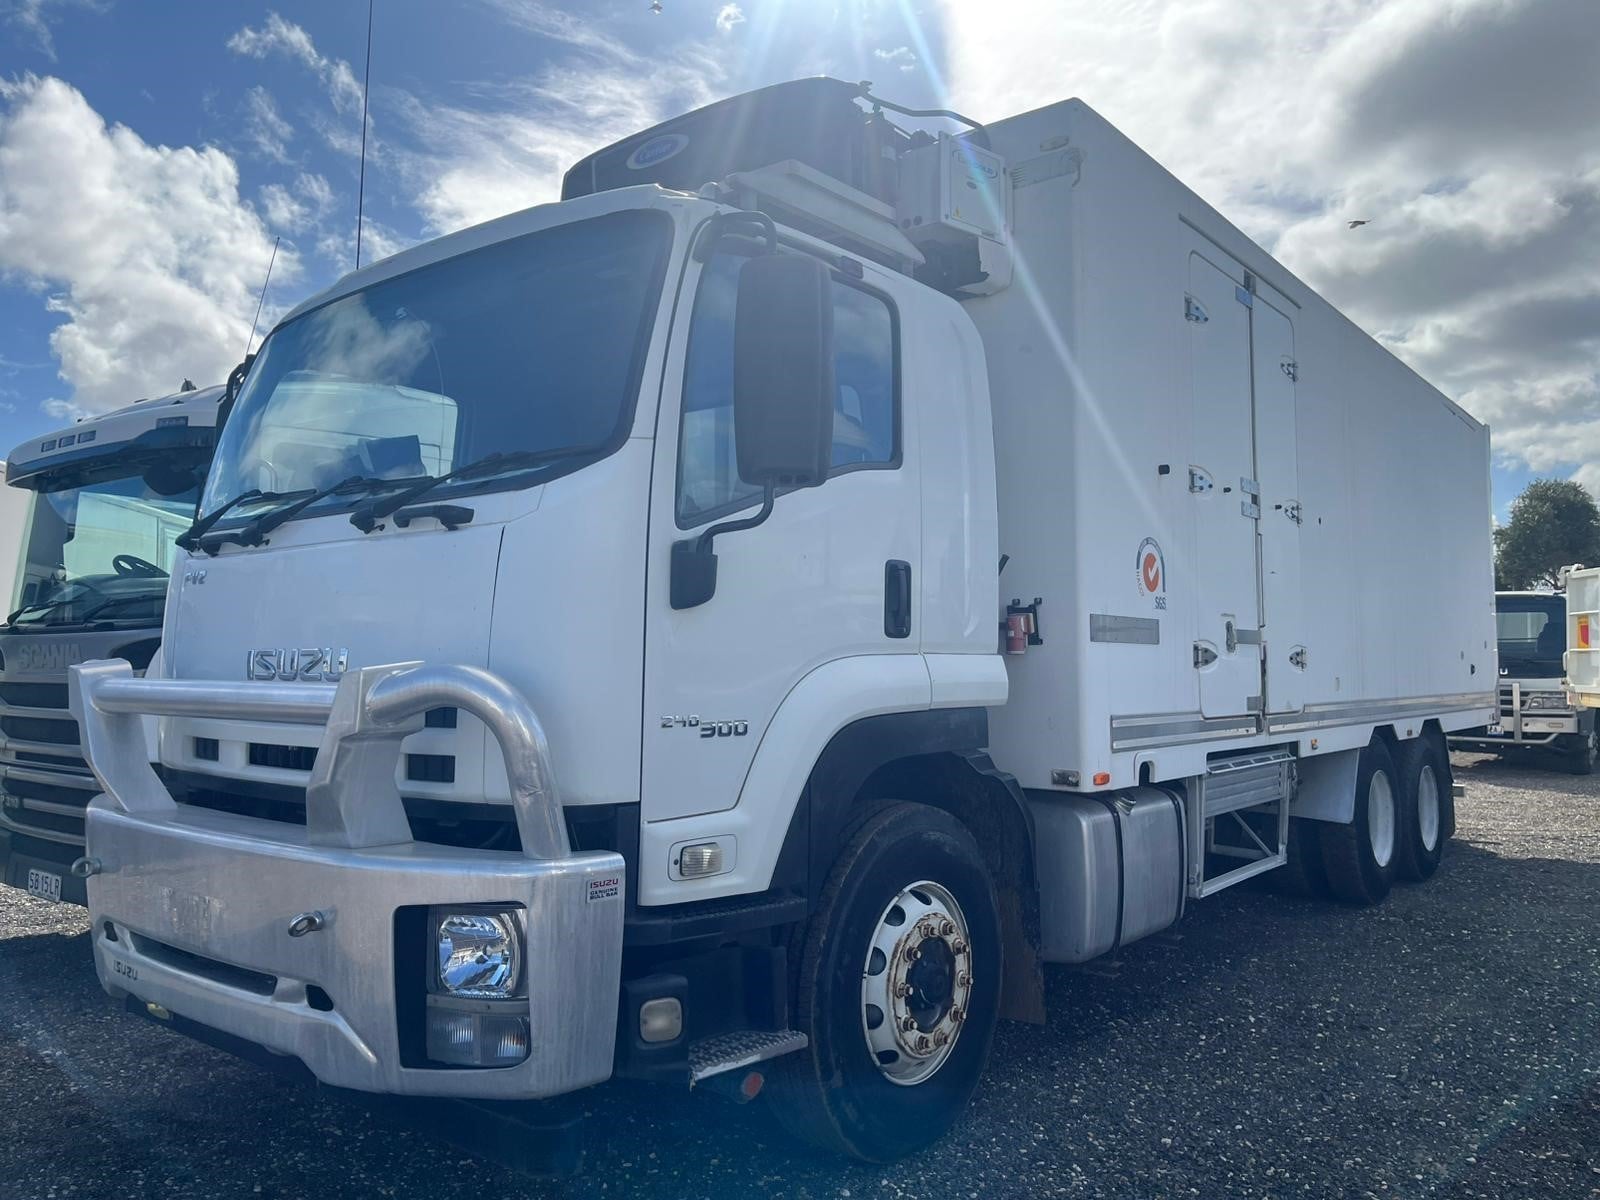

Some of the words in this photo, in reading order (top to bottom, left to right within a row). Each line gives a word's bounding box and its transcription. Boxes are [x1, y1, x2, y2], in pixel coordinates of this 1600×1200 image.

[1155, 596, 1167, 609] SGS
[19, 643, 80, 670] SCANIA
[247, 648, 349, 682] ISUZU
[661, 715, 699, 728] 240
[700, 720, 747, 738] 300
[30, 871, 60, 897] SB15LR
[590, 878, 618, 889] ISUZU
[113, 959, 138, 980] ISUZU
